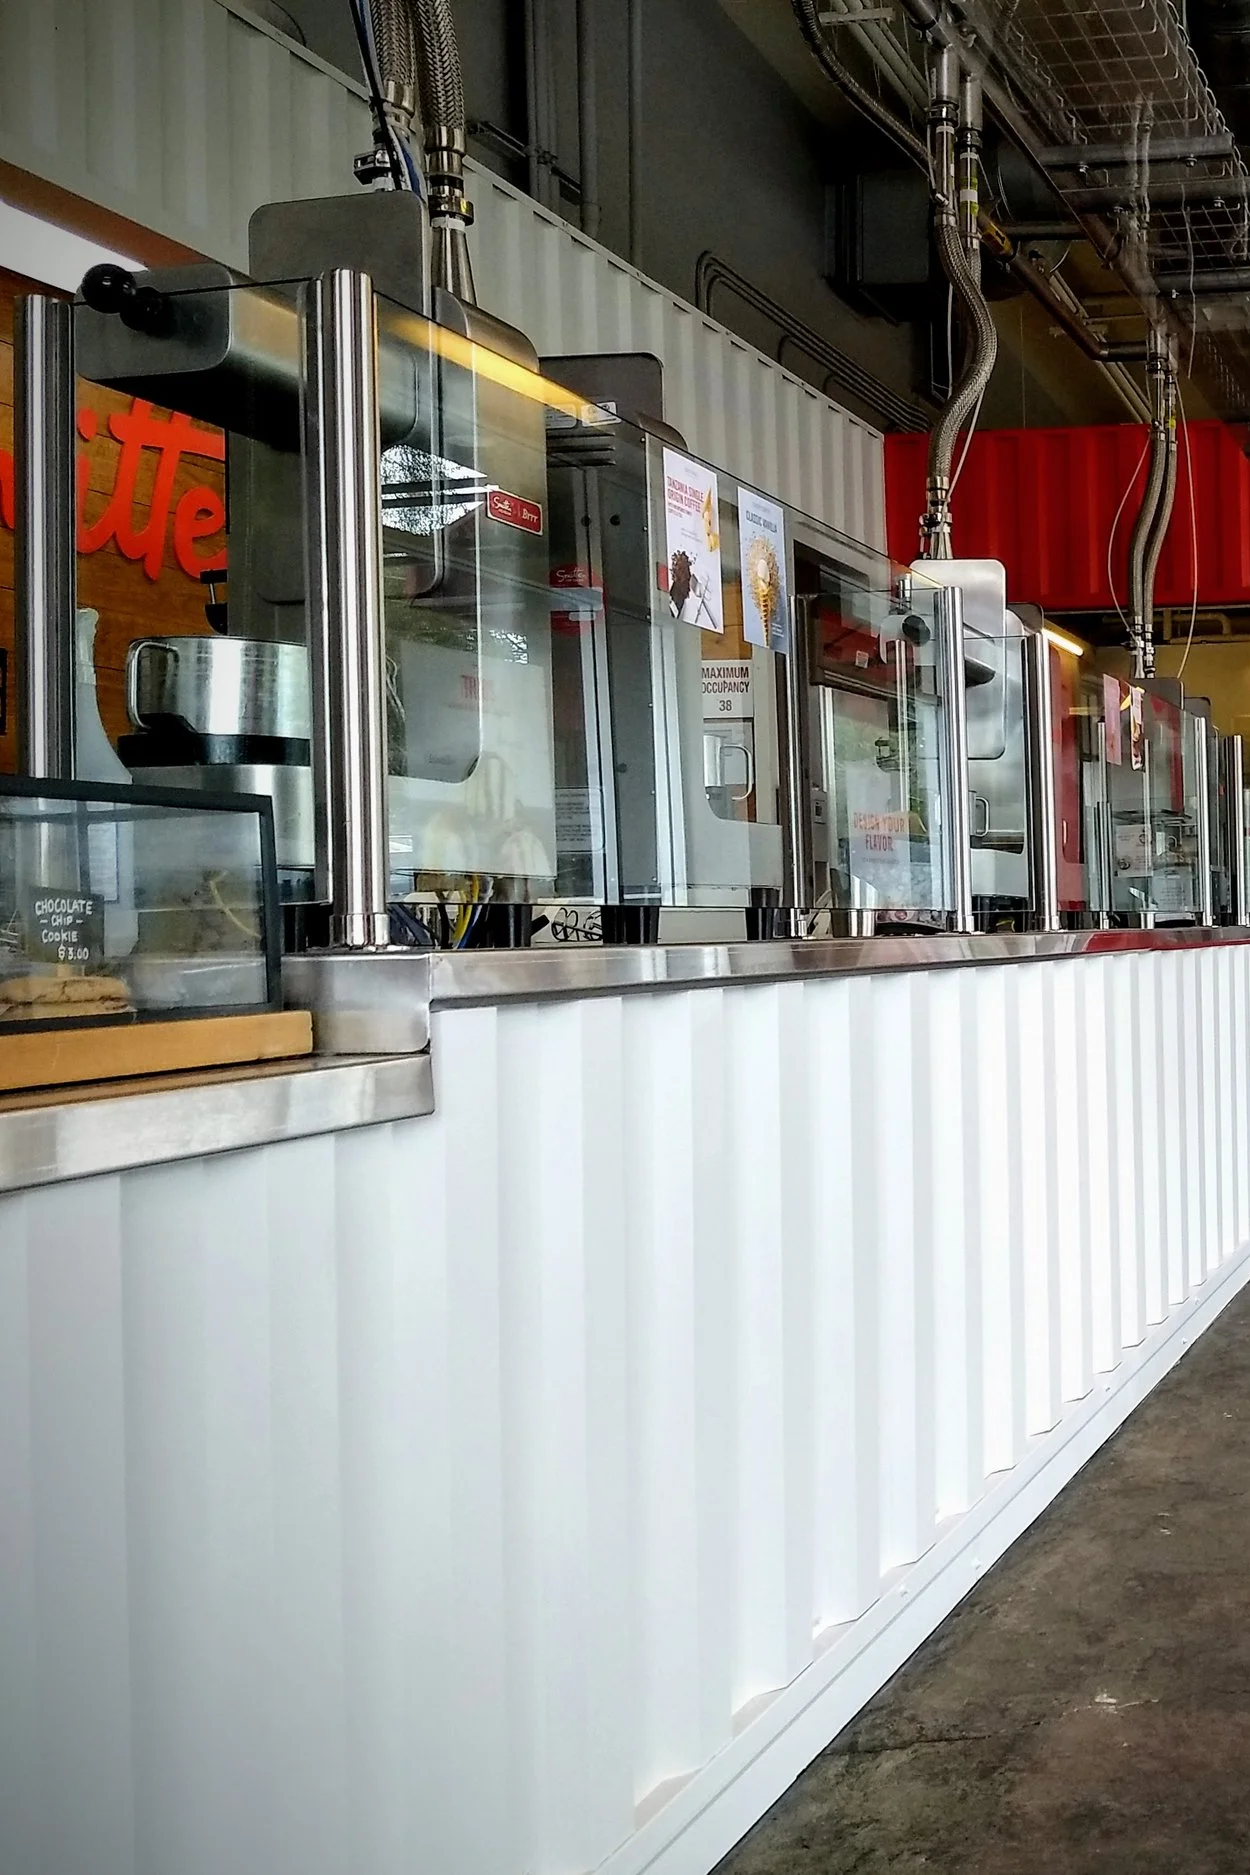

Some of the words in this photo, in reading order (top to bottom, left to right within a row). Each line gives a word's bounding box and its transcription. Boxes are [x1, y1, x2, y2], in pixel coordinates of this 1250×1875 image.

[521, 508, 538, 523] Brrr
[701, 666, 750, 679] MAXIMUM
[701, 680, 750, 694] OCCUPANCY
[719, 699, 732, 712] 38
[882, 815, 905, 832] YOUR
[865, 834, 893, 852] FLAVOR
[34, 898, 93, 915] CHOCOLATE
[51, 914, 73, 926] CHIP
[57, 943, 89, 960] $3.00
